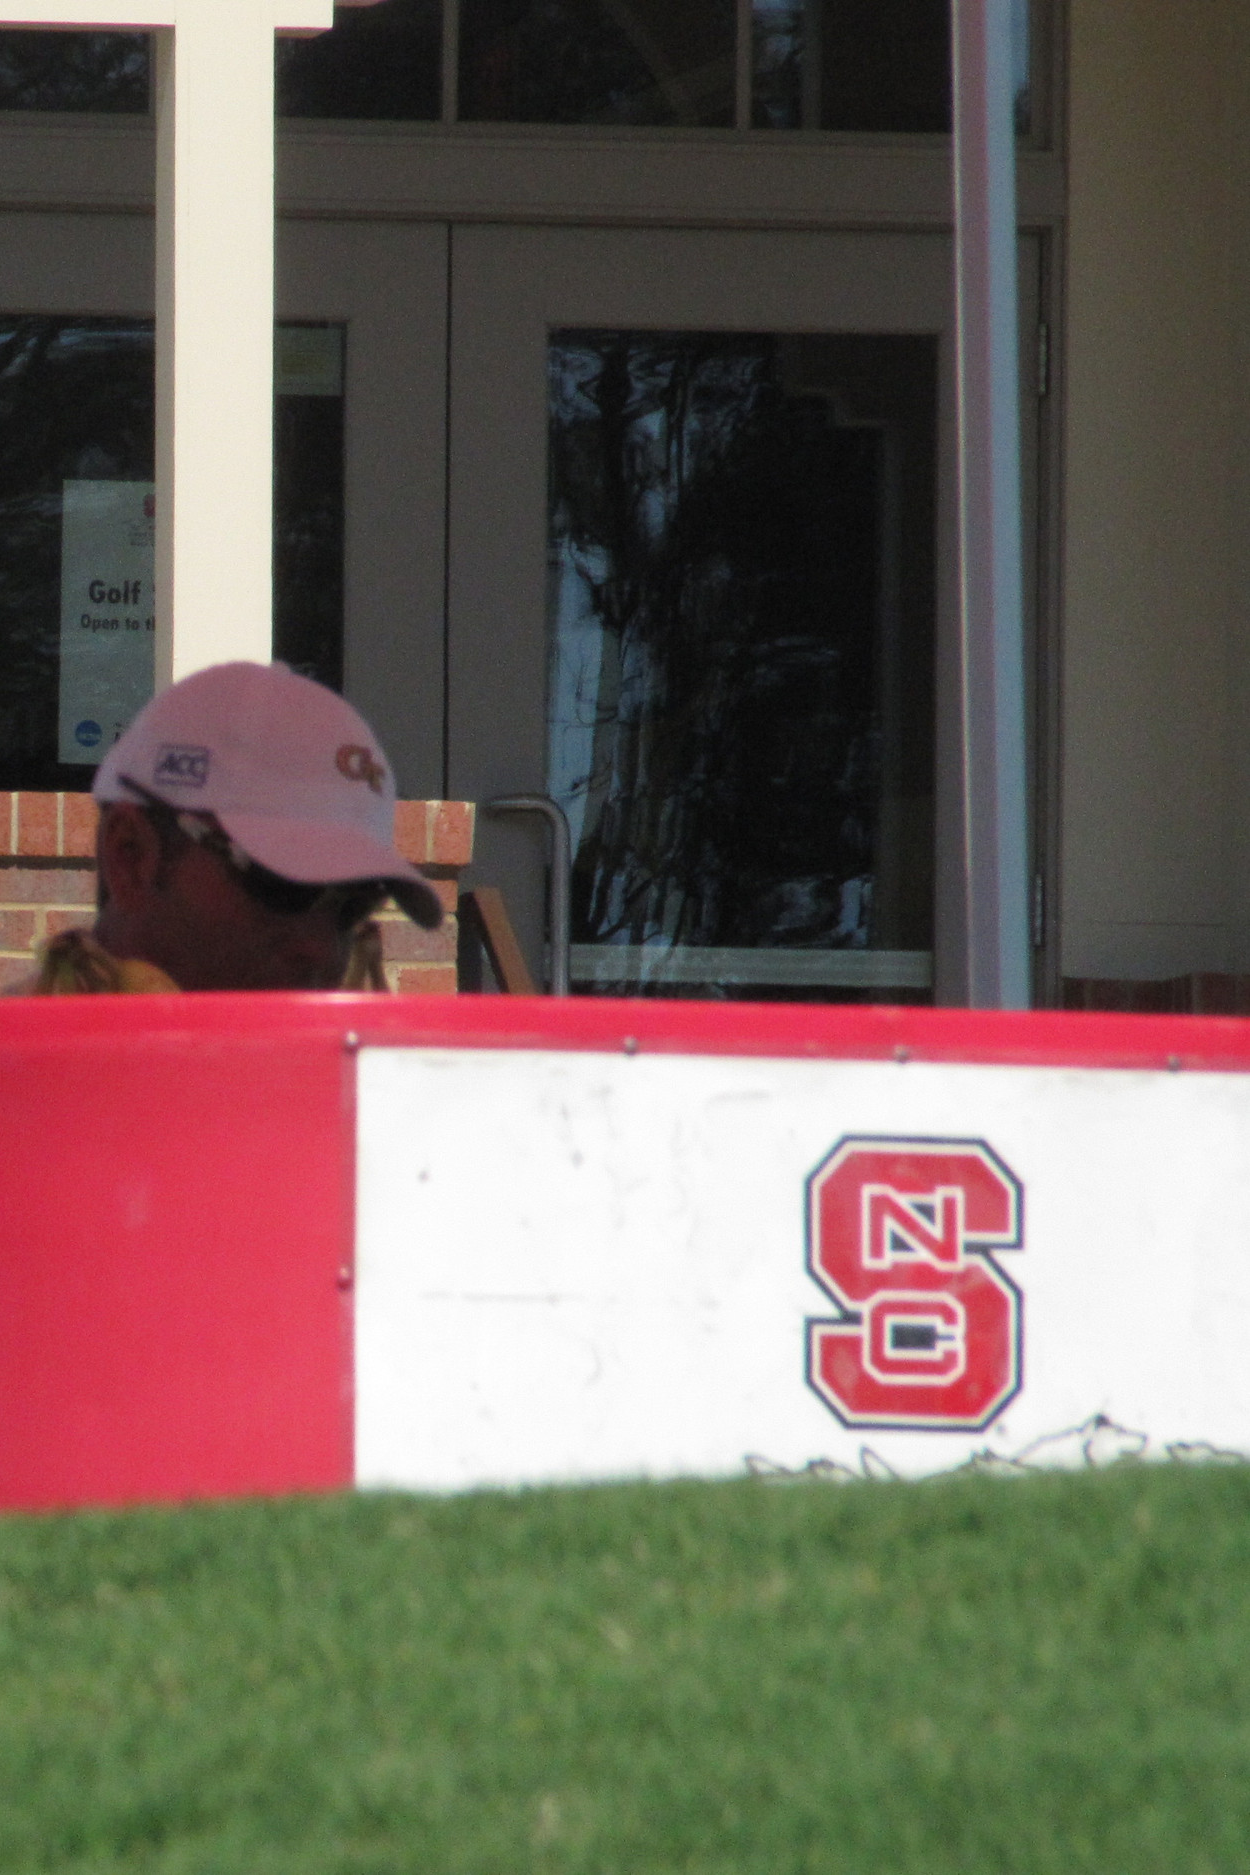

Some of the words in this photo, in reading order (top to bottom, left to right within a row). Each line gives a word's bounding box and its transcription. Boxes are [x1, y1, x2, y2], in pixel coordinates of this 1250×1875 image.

[89, 579, 141, 604] Golf
[80, 613, 119, 633] Open
[125, 616, 140, 631] to
[154, 752, 209, 779] ACC
